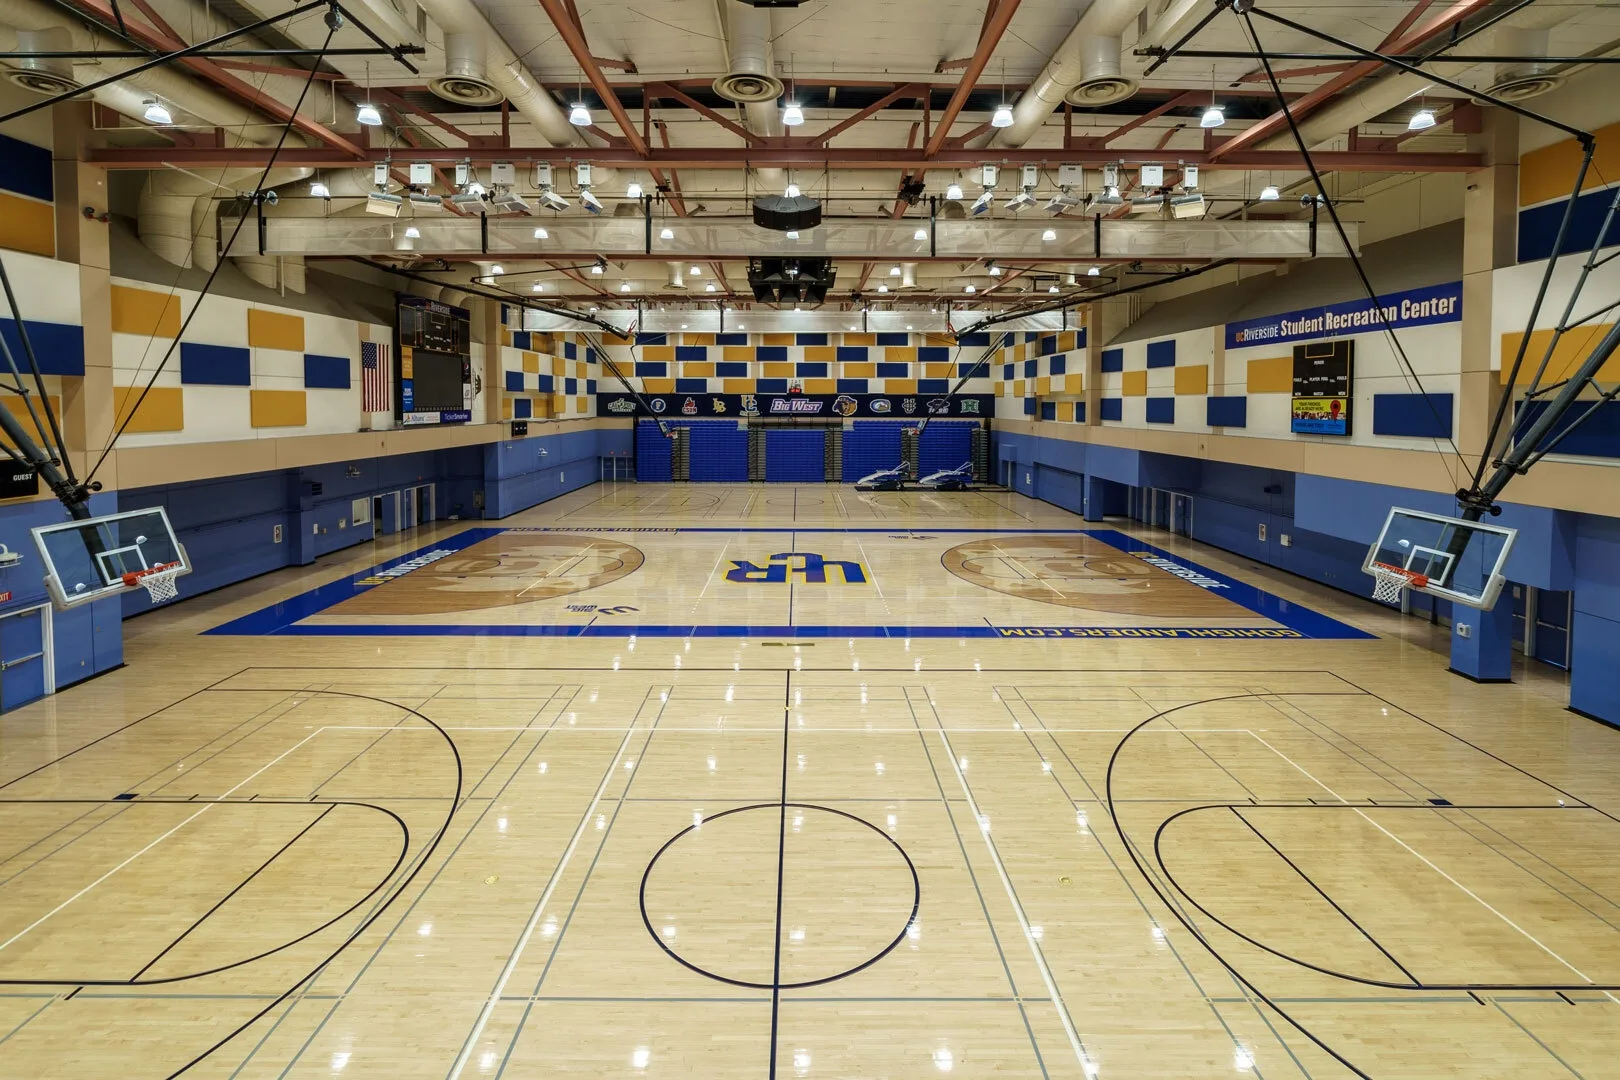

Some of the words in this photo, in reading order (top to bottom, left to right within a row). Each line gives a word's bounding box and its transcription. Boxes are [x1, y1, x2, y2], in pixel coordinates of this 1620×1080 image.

[1280, 316, 1324, 336] Student
[1326, 305, 1398, 330] Recreation
[1401, 295, 1457, 320] Center
[773, 400, 790, 411] BIG
[790, 399, 820, 411] WEST
[13, 473, 33, 481] GUEST
[722, 552, 870, 584] UCR
[1142, 558, 1231, 588] RIVERSIDE
[0, 592, 9, 602] XIT
[1000, 627, 1303, 638] GOHIGHLANDERS.COM
